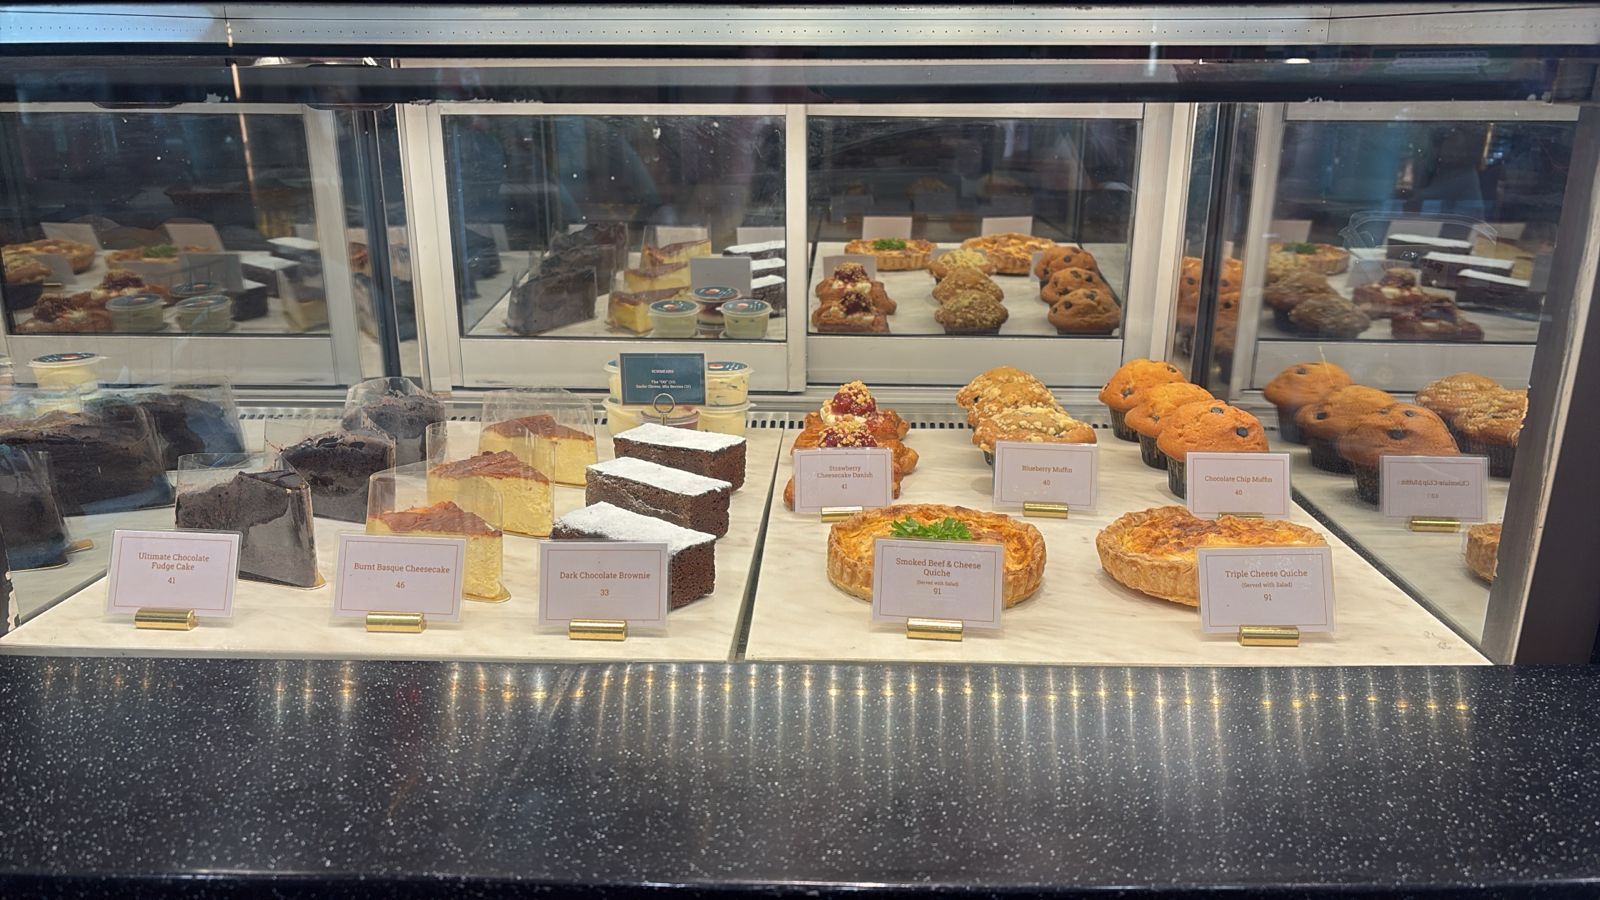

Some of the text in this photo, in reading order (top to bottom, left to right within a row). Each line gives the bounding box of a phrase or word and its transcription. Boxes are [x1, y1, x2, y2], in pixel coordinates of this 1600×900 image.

[1022, 465, 1051, 473] Blueberry
[138, 552, 210, 562] Ultimate Chocolate
[151, 562, 195, 571] Fudge Cake
[896, 558, 926, 566] Smoked
[954, 561, 981, 569] Cheese
[377, 564, 404, 572] Basque
[406, 565, 450, 573] Cheesecake
[923, 569, 950, 577] Quiche
[1225, 570, 1249, 579] Triple
